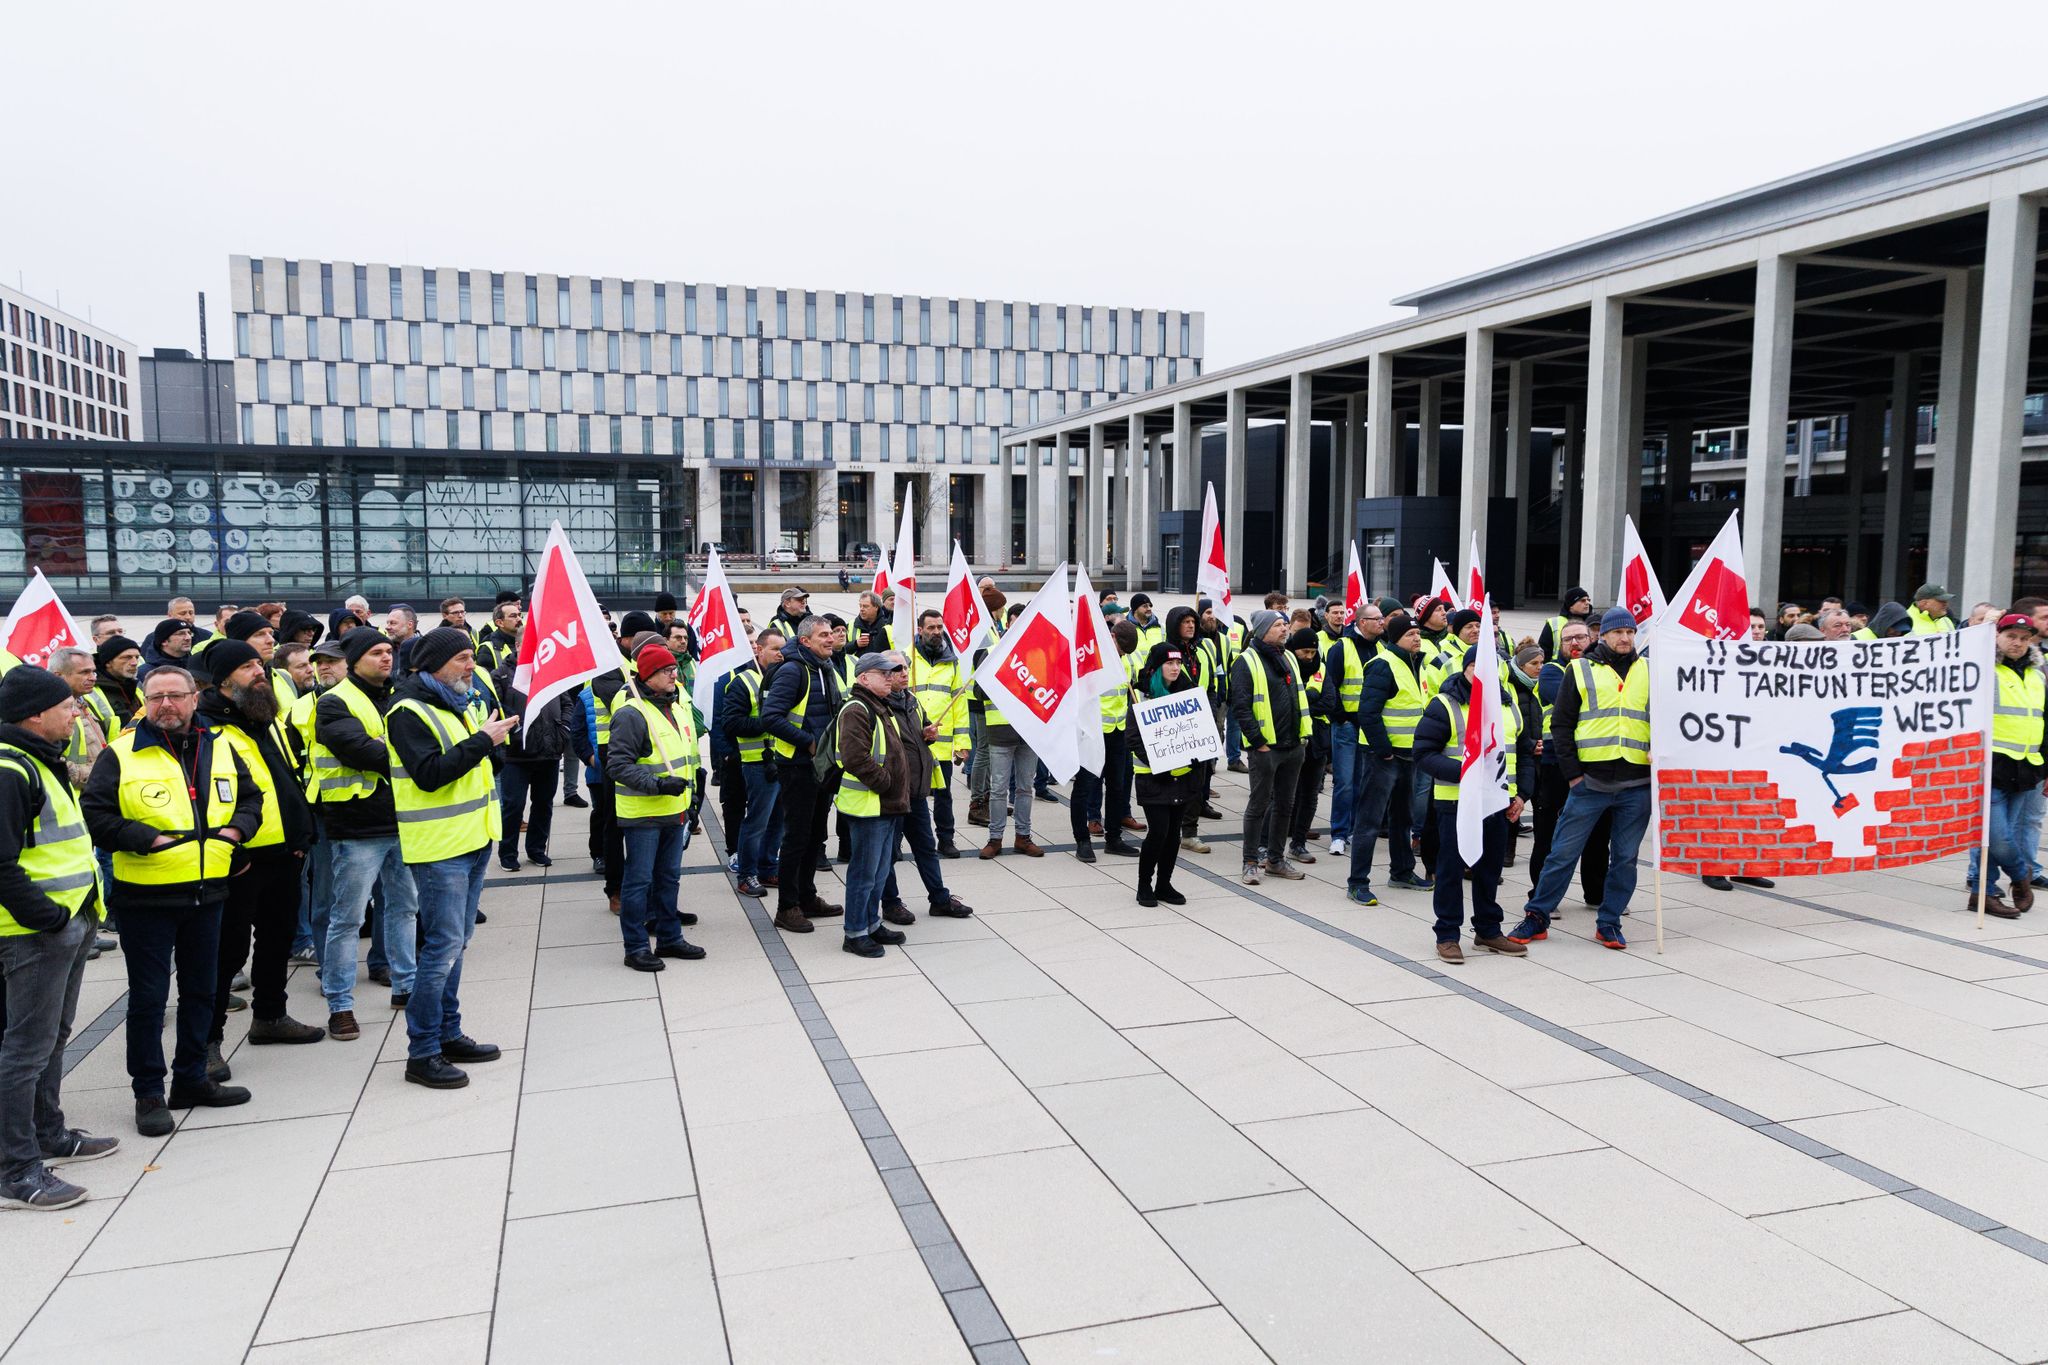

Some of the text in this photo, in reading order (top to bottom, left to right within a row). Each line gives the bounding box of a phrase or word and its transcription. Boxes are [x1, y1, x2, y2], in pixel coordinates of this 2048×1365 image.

[743, 460, 804, 468] STEIENBERGER
[1009, 653, 1059, 710] ver.di
[1677, 661, 1980, 700] MIT TARIFUNTERSCHIED
[1141, 698, 1203, 726] LUFTHANSA
[1893, 698, 1972, 733] WEST
[1679, 712, 1751, 749] OST
